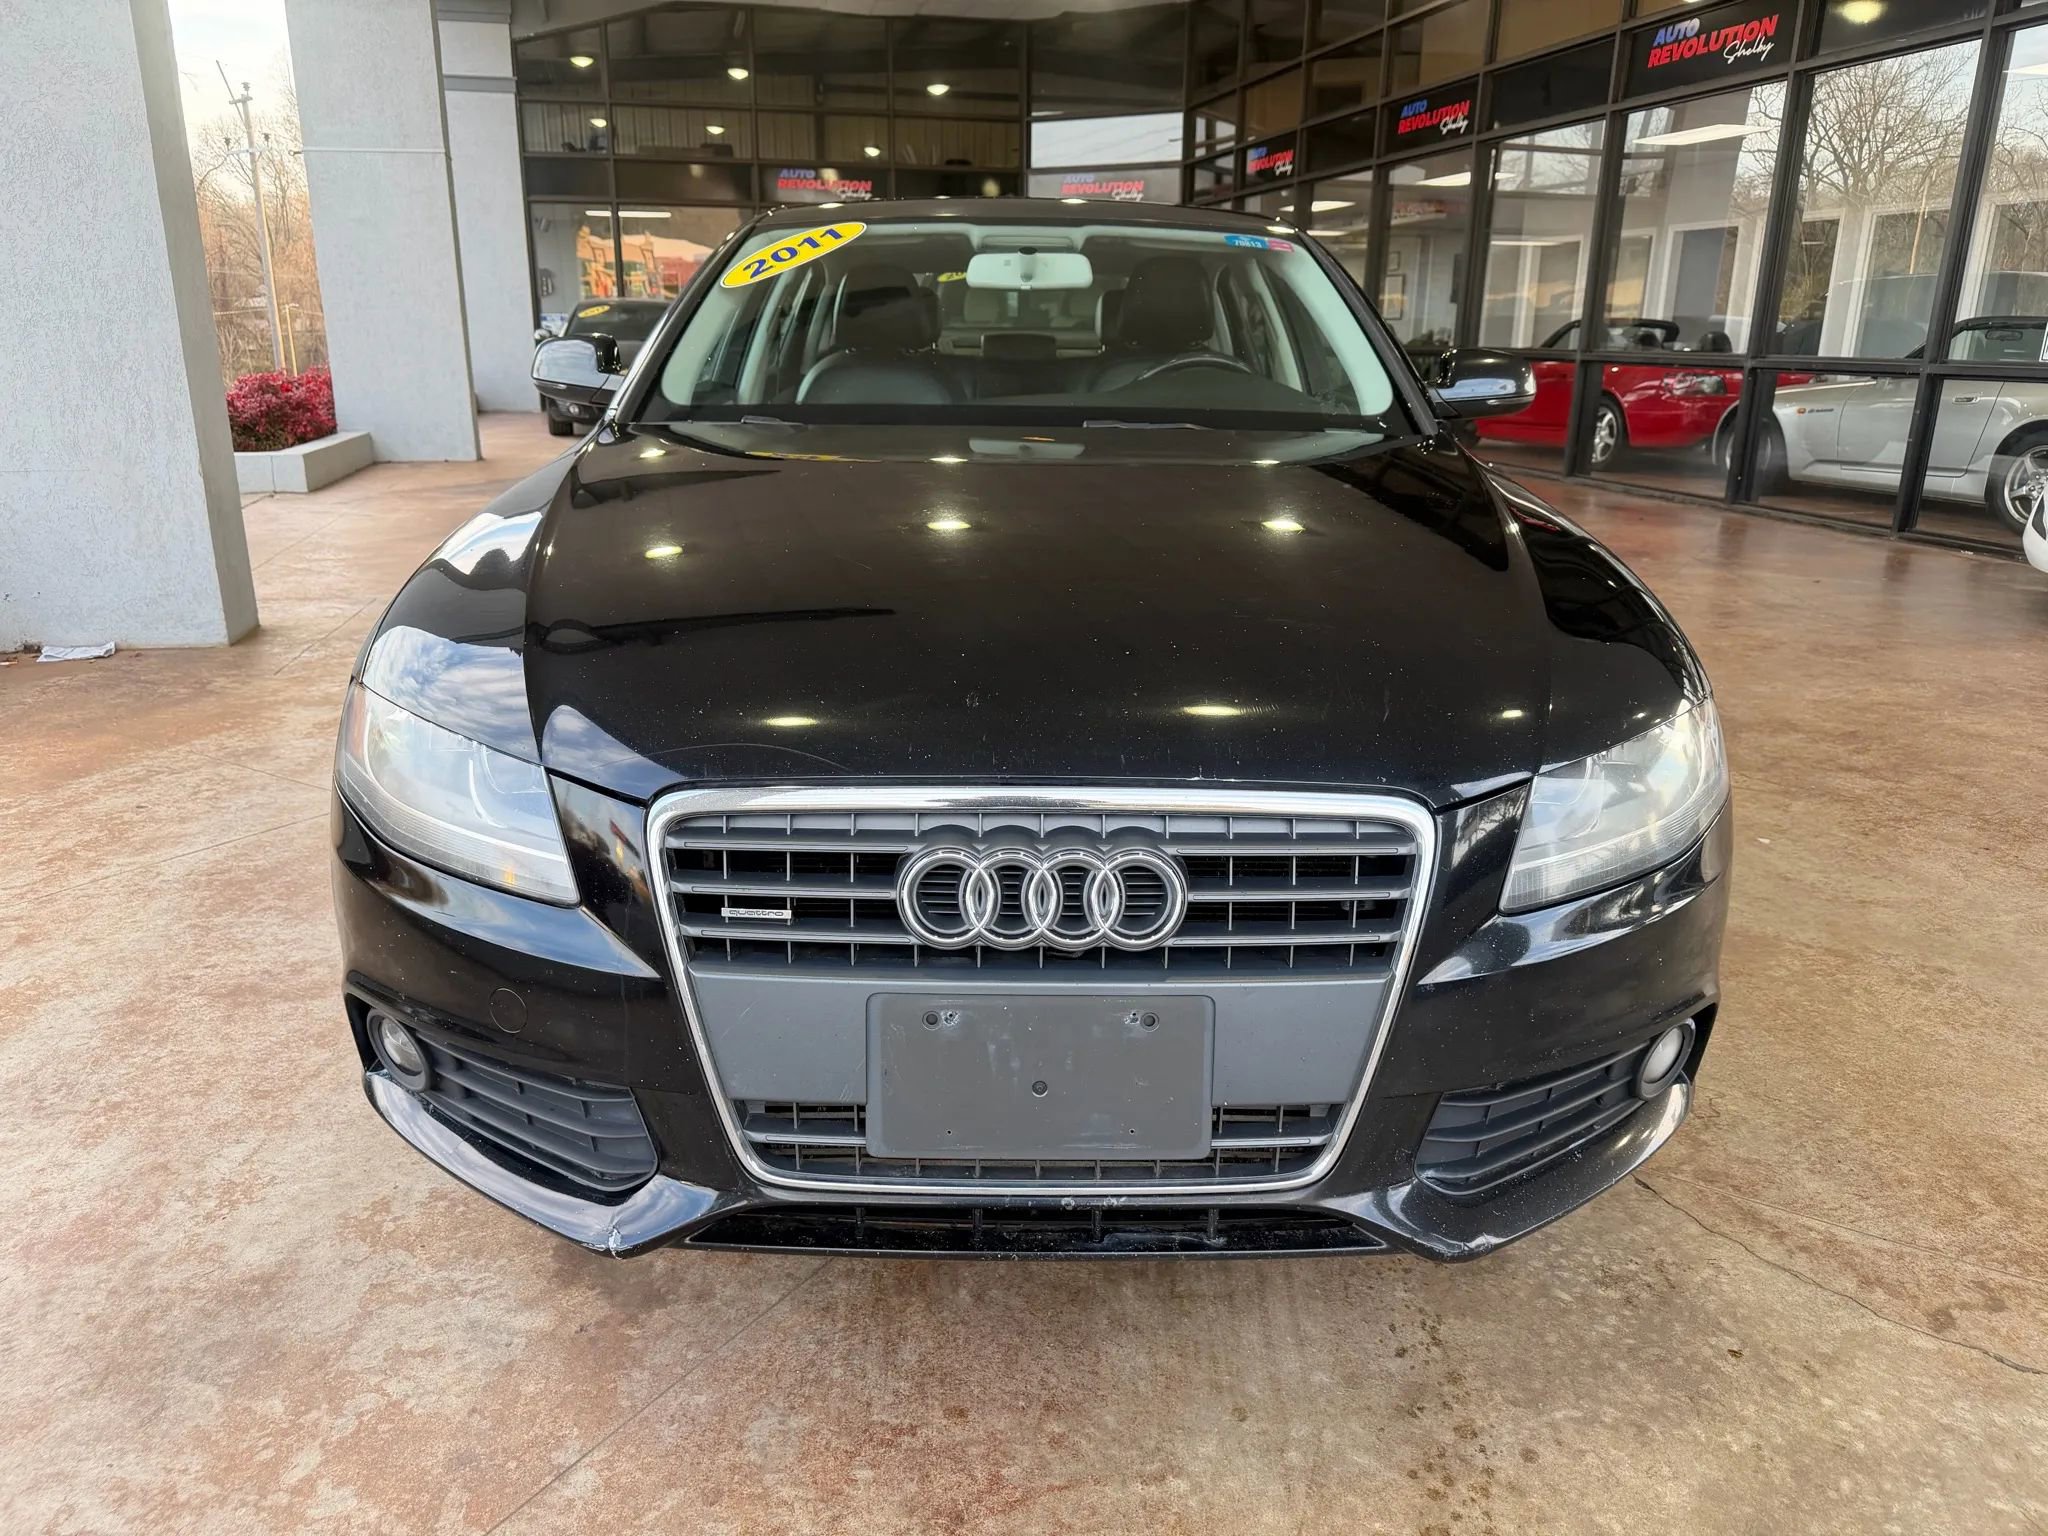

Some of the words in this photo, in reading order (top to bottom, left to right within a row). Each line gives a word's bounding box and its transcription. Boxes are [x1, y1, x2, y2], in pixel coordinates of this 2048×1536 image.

[1648, 14, 1779, 68] REVOLUTION
[1652, 18, 1700, 46] AUTO
[1723, 32, 1774, 64] Shelby
[1398, 100, 1470, 134] REVOLUTION
[1401, 99, 1428, 118] AUTO
[780, 168, 816, 178] AUTO
[1063, 173, 1095, 183] AUTO
[777, 179, 872, 192] REVOLUTION
[1060, 180, 1144, 195] REVOLUTION
[743, 228, 844, 279] 2011
[729, 909, 784, 917] quattro
